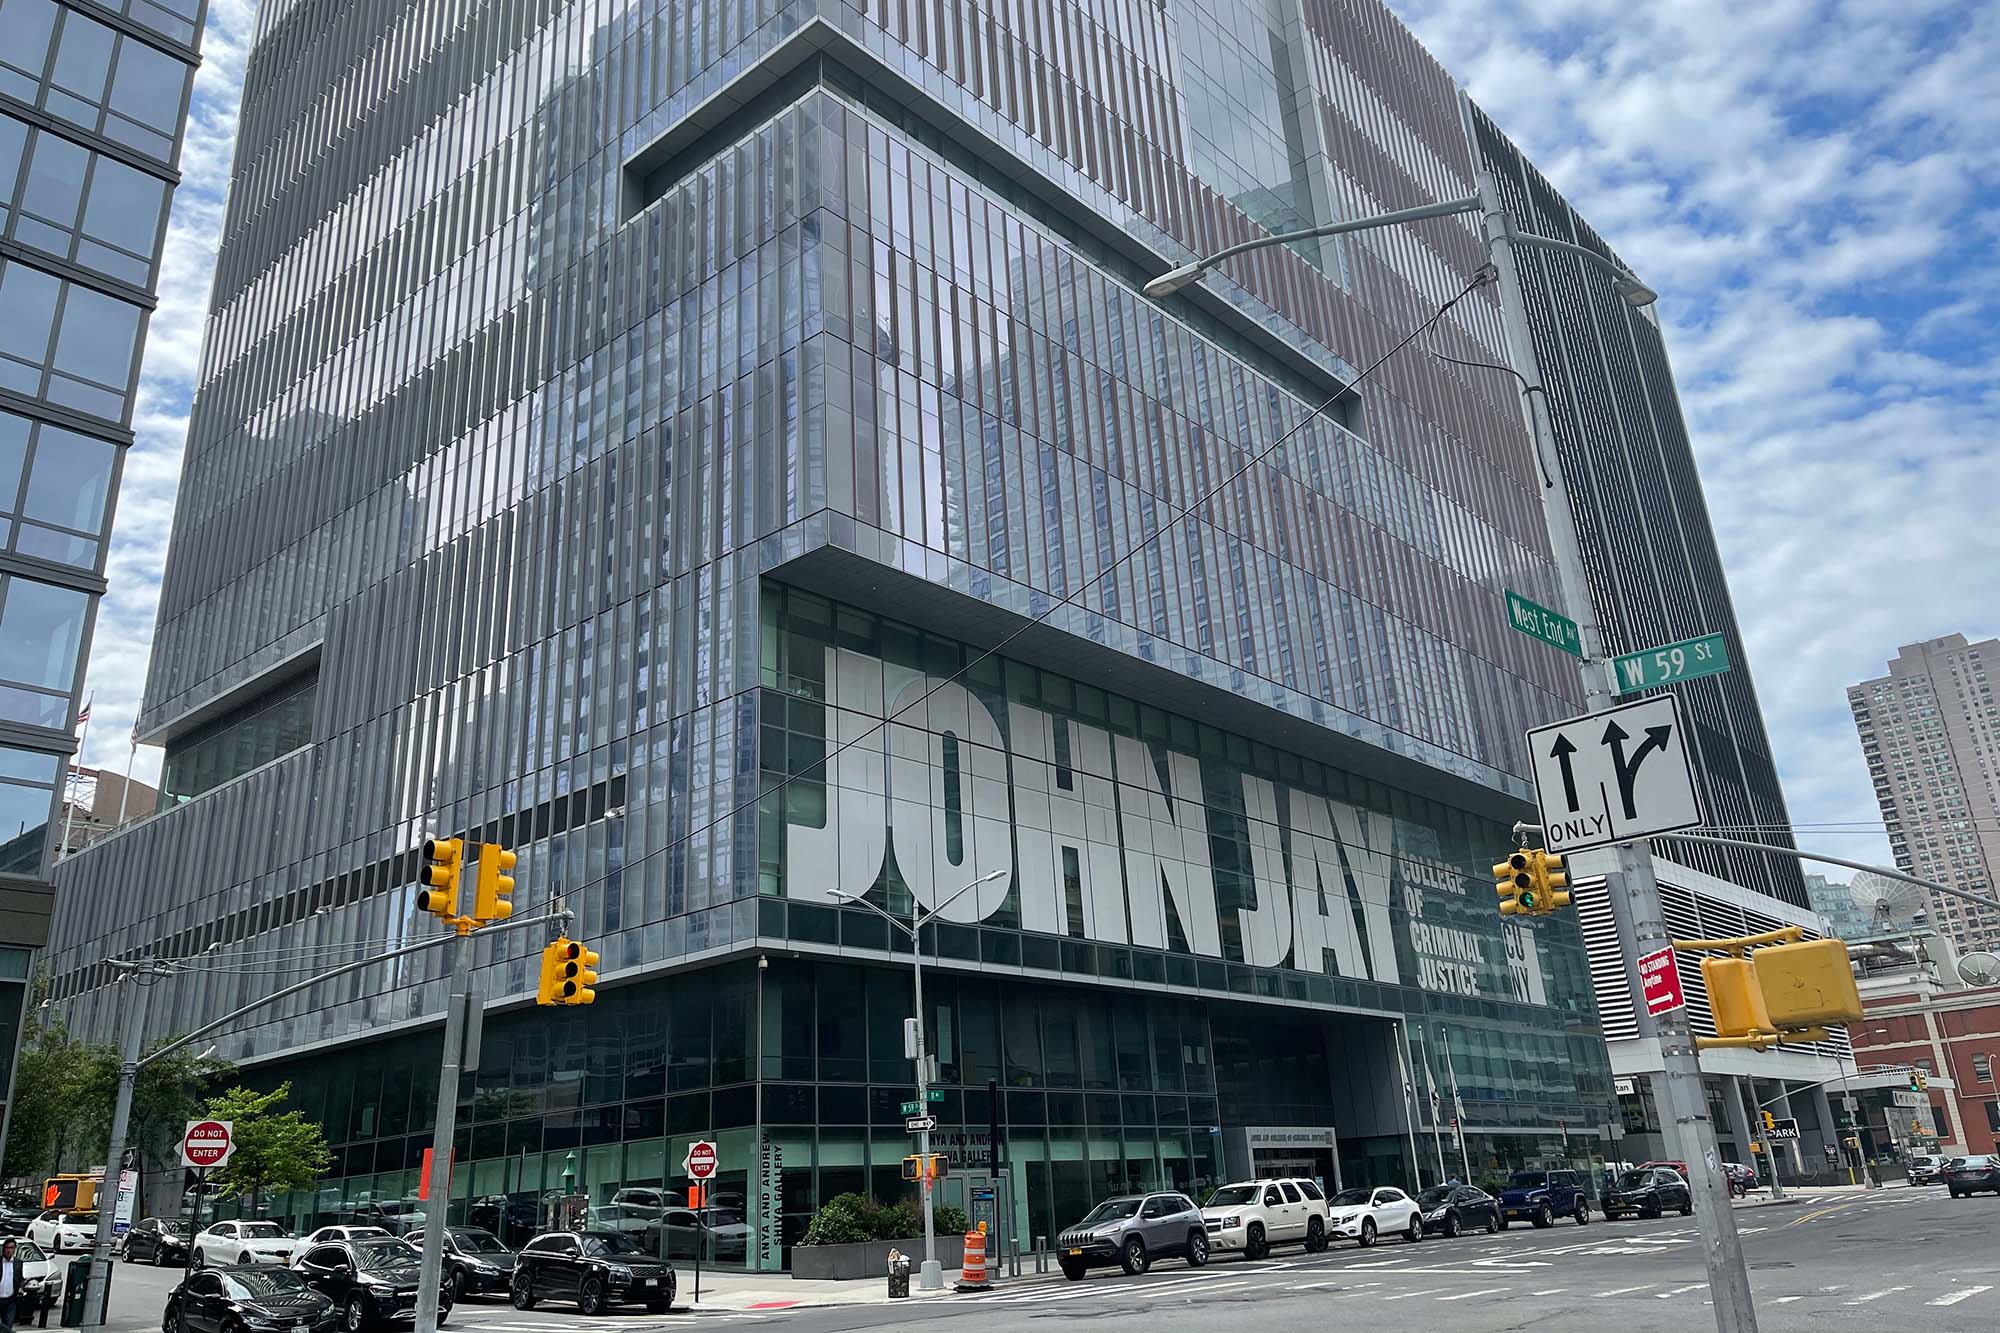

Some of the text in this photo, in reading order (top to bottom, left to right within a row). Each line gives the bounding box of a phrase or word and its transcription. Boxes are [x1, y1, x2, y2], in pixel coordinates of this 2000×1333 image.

[1510, 597, 1541, 635] West
[1542, 612, 1565, 645] End
[1624, 642, 1713, 686] W 59 St
[787, 646, 1401, 984] JOHN JAY
[1550, 814, 1604, 842] ONLY
[1399, 851, 1466, 895] COLLEGE
[1403, 885, 1424, 918] OF
[1409, 921, 1484, 963] CRIMINAL
[1502, 922, 1525, 962] CU
[1417, 957, 1480, 996] JUSTICE
[1509, 964, 1532, 1003] NY
[1640, 955, 1670, 975] NO STANDING
[192, 1149, 219, 1157] ENTER
[194, 1130, 223, 1138] DO NOT
[950, 1133, 967, 1146] AND
[694, 1164, 710, 1172] ENTER
[961, 1150, 992, 1162] GALLER
[761, 1132, 770, 1260] ANYA AND ANDREW
[773, 1144, 782, 1246] SHIVA GALLERY
